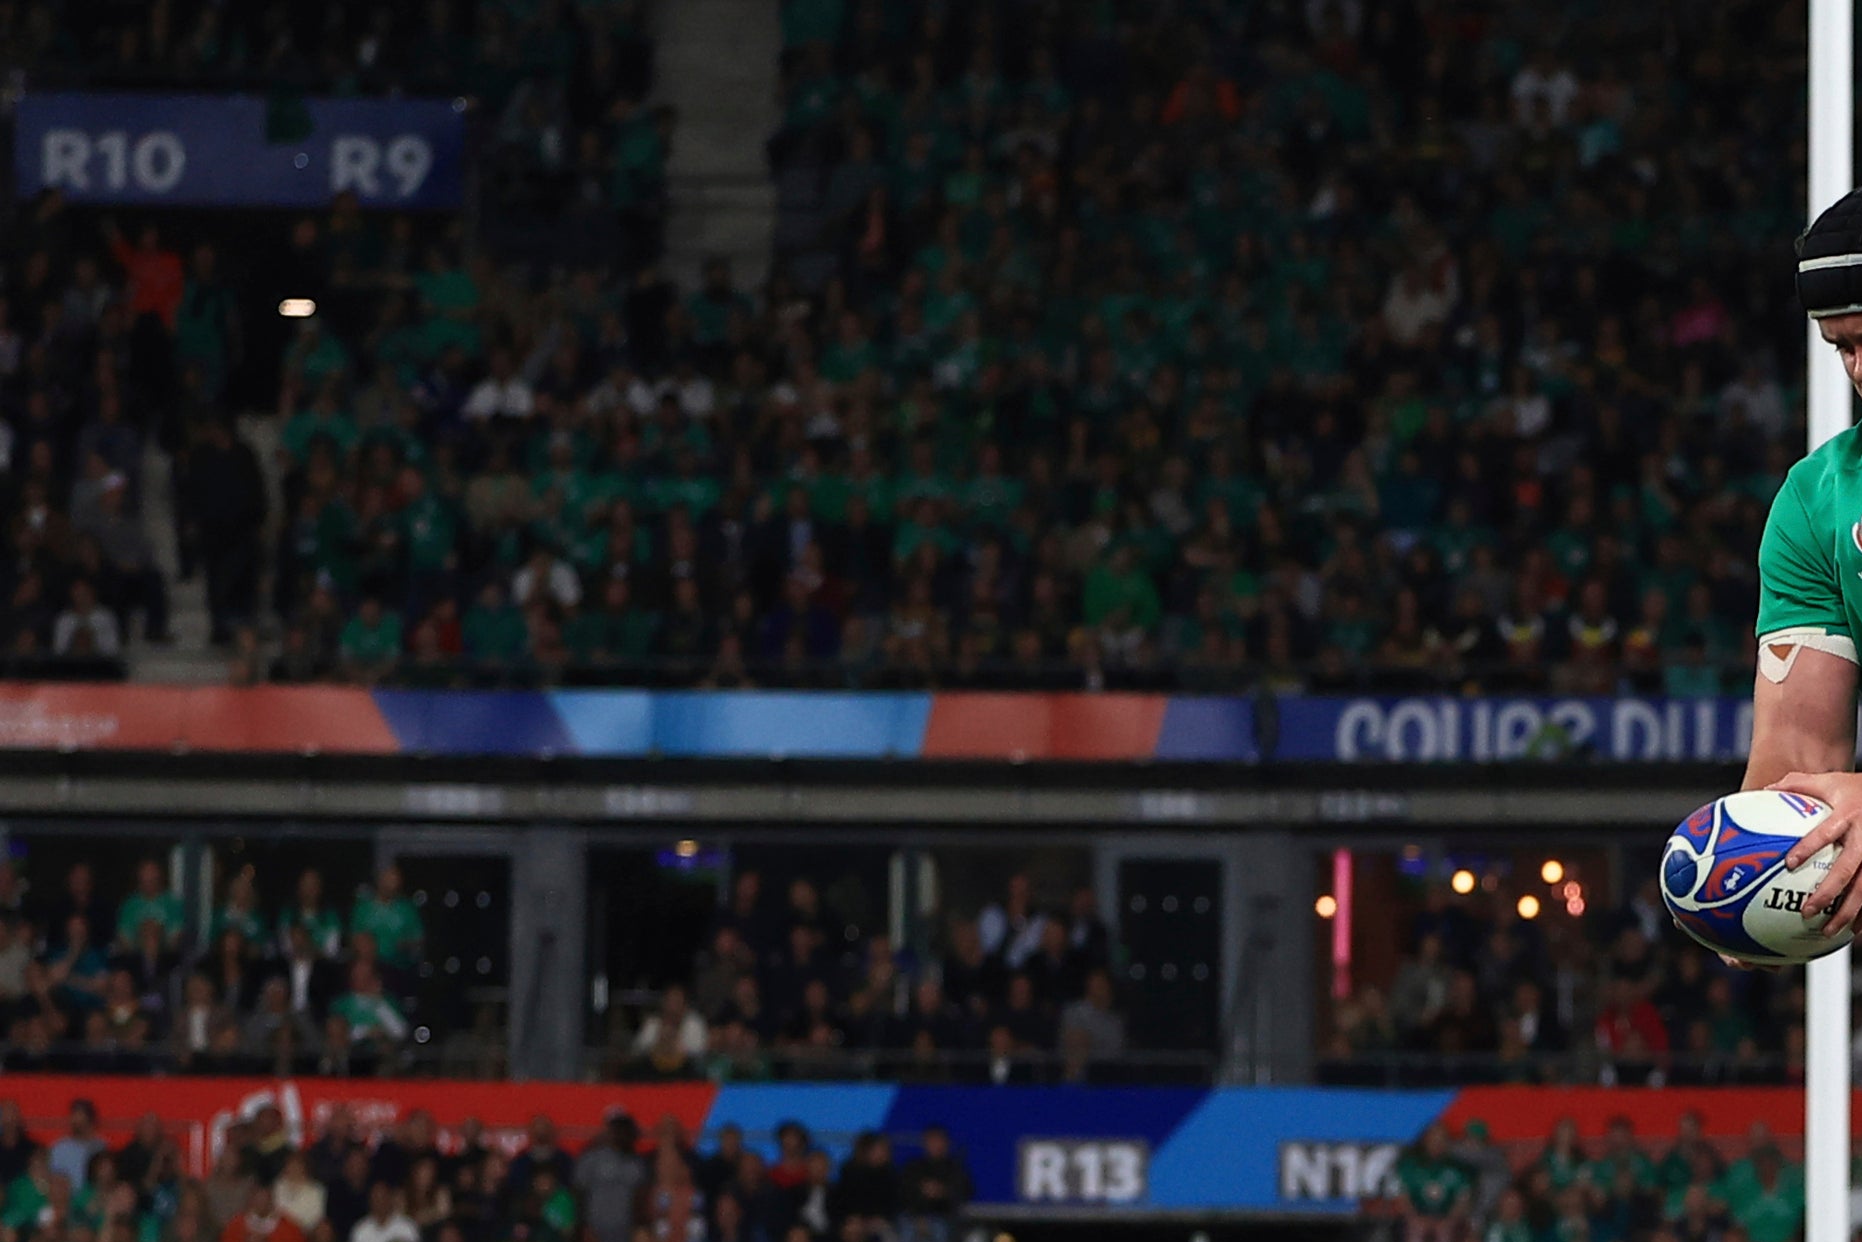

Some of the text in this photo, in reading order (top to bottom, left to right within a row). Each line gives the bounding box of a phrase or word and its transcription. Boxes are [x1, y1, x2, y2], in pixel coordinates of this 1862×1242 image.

[42, 130, 186, 194] R10
[331, 136, 432, 197] R9
[1023, 1140, 1143, 1200] R13
